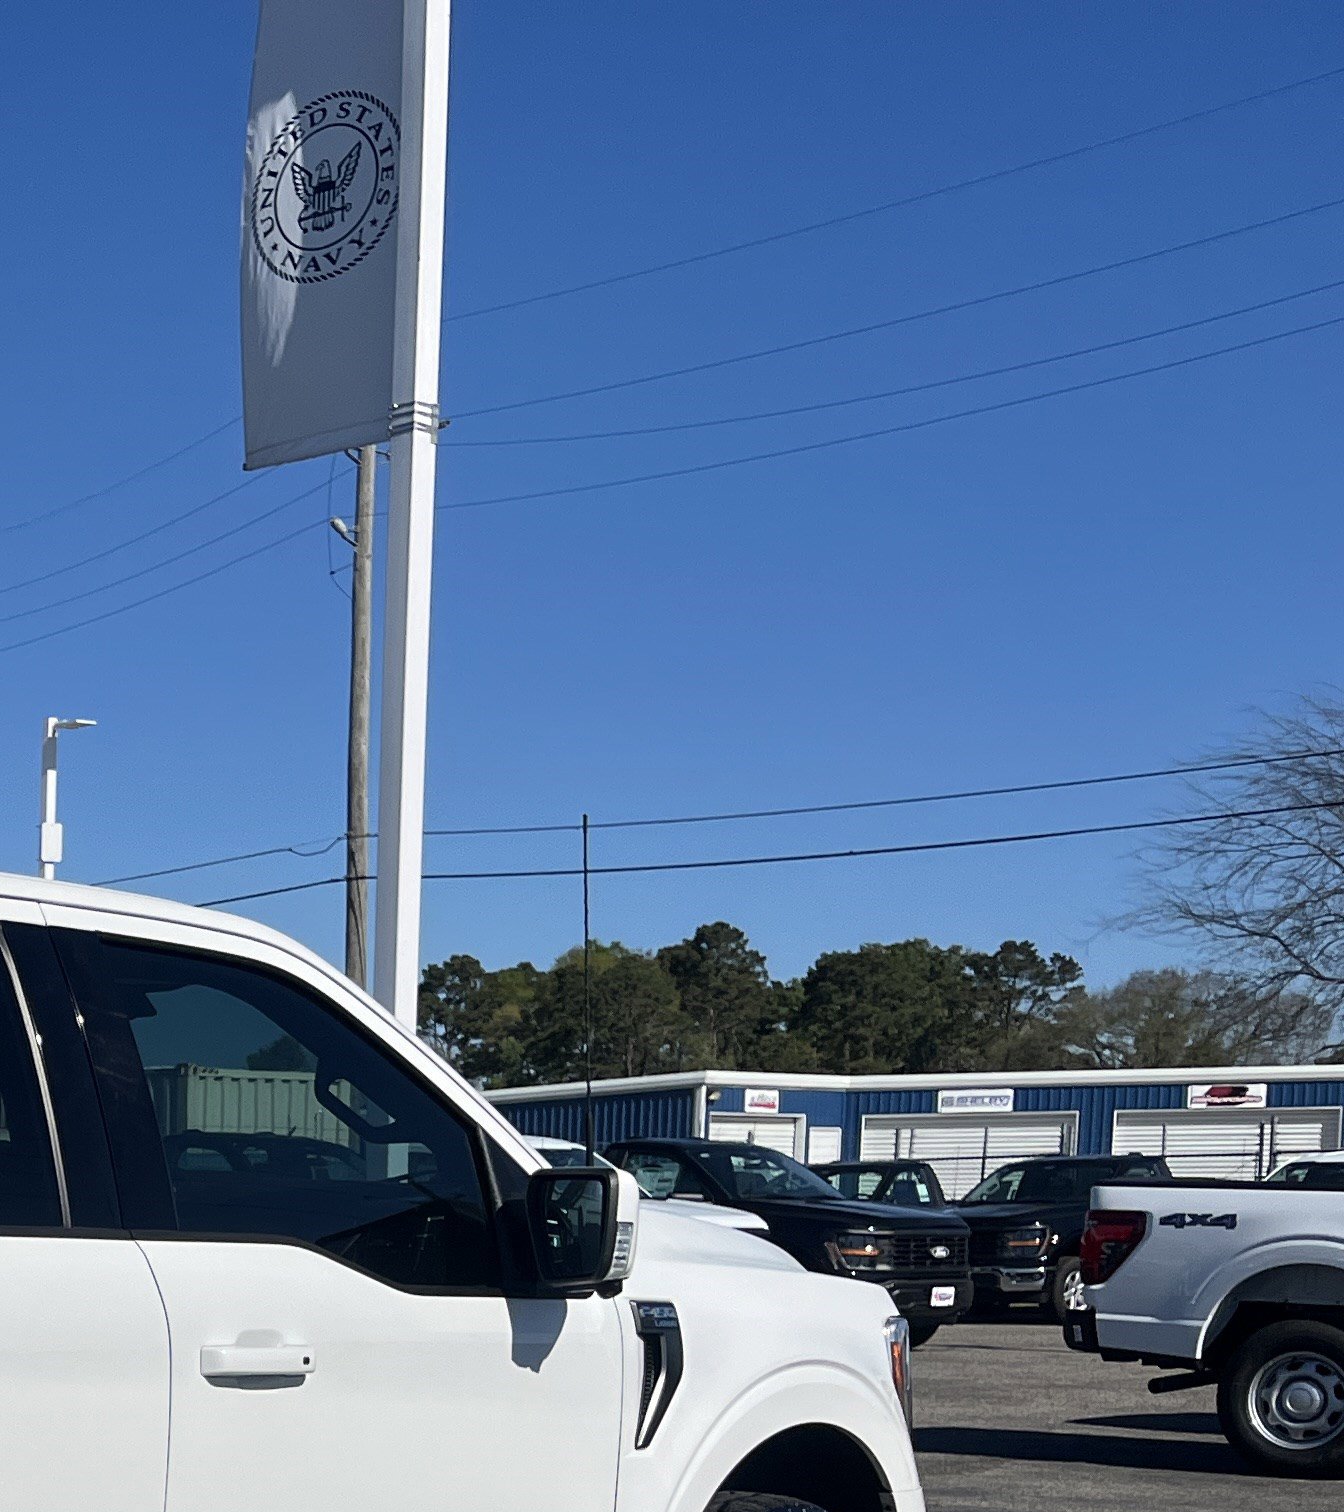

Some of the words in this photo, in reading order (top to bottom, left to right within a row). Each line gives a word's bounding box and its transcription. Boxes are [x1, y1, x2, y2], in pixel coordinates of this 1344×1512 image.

[260, 107, 328, 239] UNITED
[336, 101, 395, 206] STATES
[280, 227, 366, 273] NAVY
